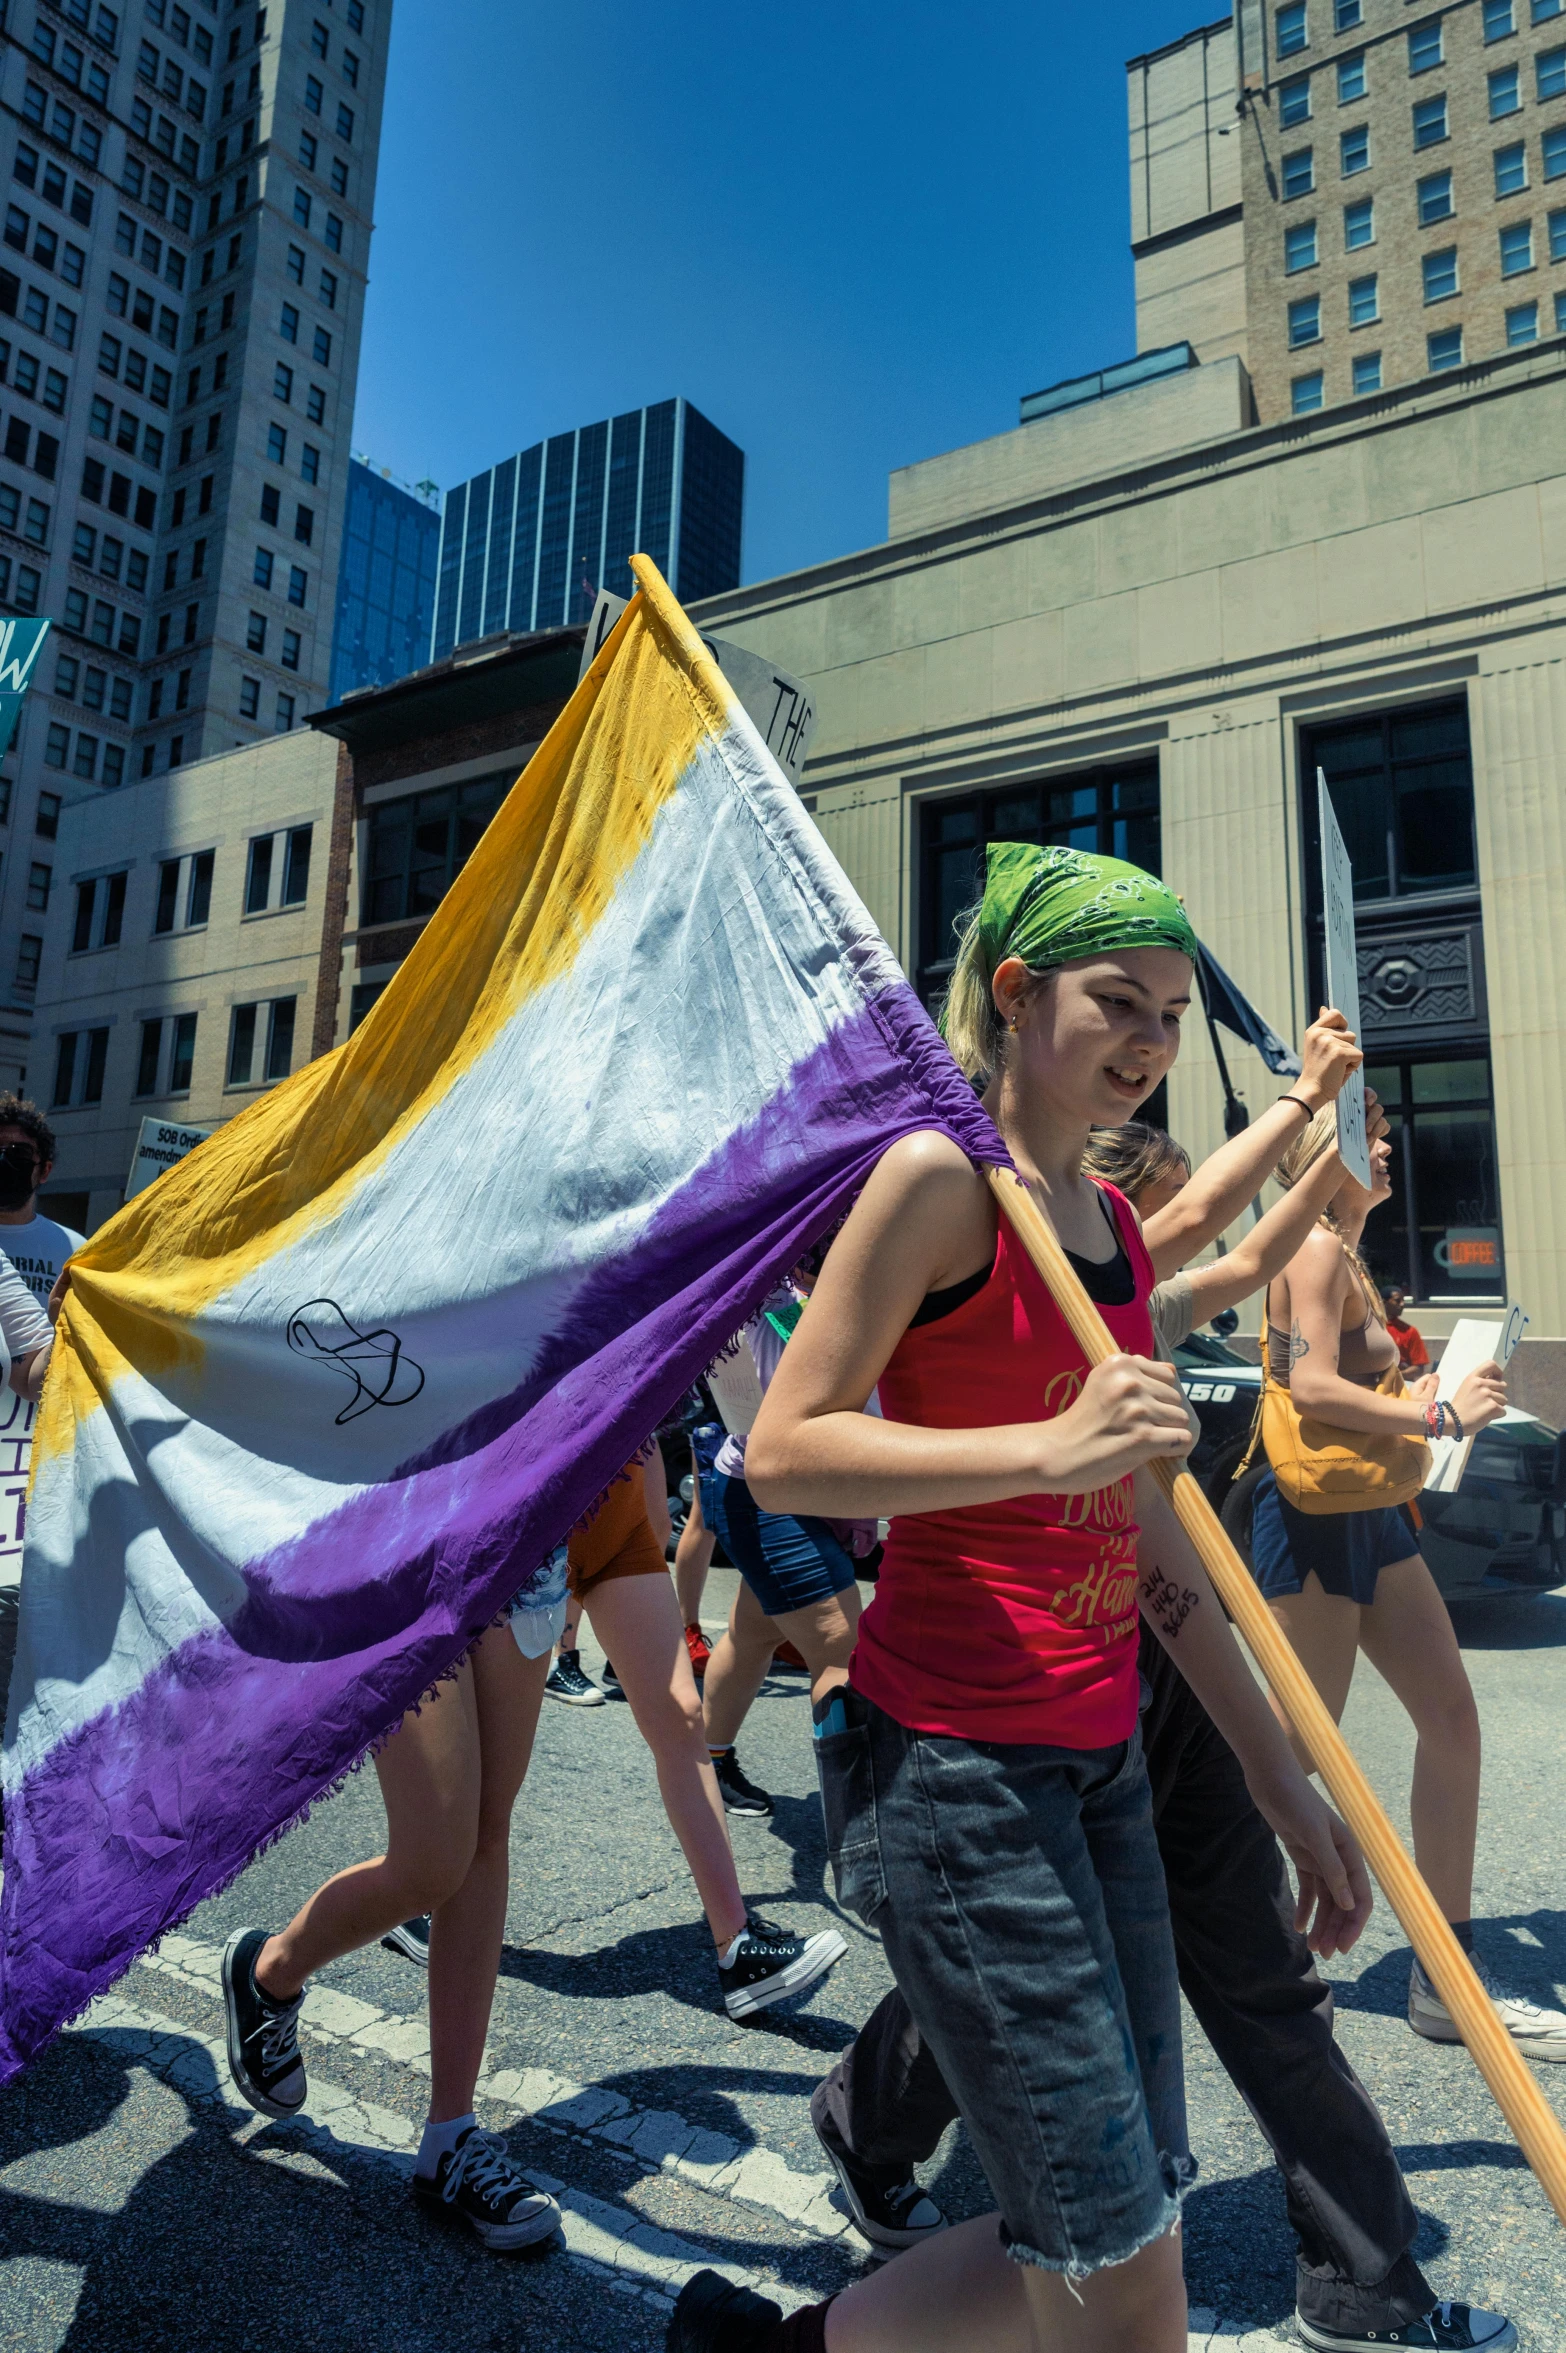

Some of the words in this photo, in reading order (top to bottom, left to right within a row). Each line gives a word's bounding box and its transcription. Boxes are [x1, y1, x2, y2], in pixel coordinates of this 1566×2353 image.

[764, 676, 812, 769] THE
[157, 1127, 179, 1145] SOB
[179, 1132, 205, 1150] Ordi
[139, 1145, 186, 1164] amendm
[1450, 1241, 1496, 1265] COFFEE
[1139, 1565, 1165, 1598] 214
[1151, 1582, 1179, 1614] 440
